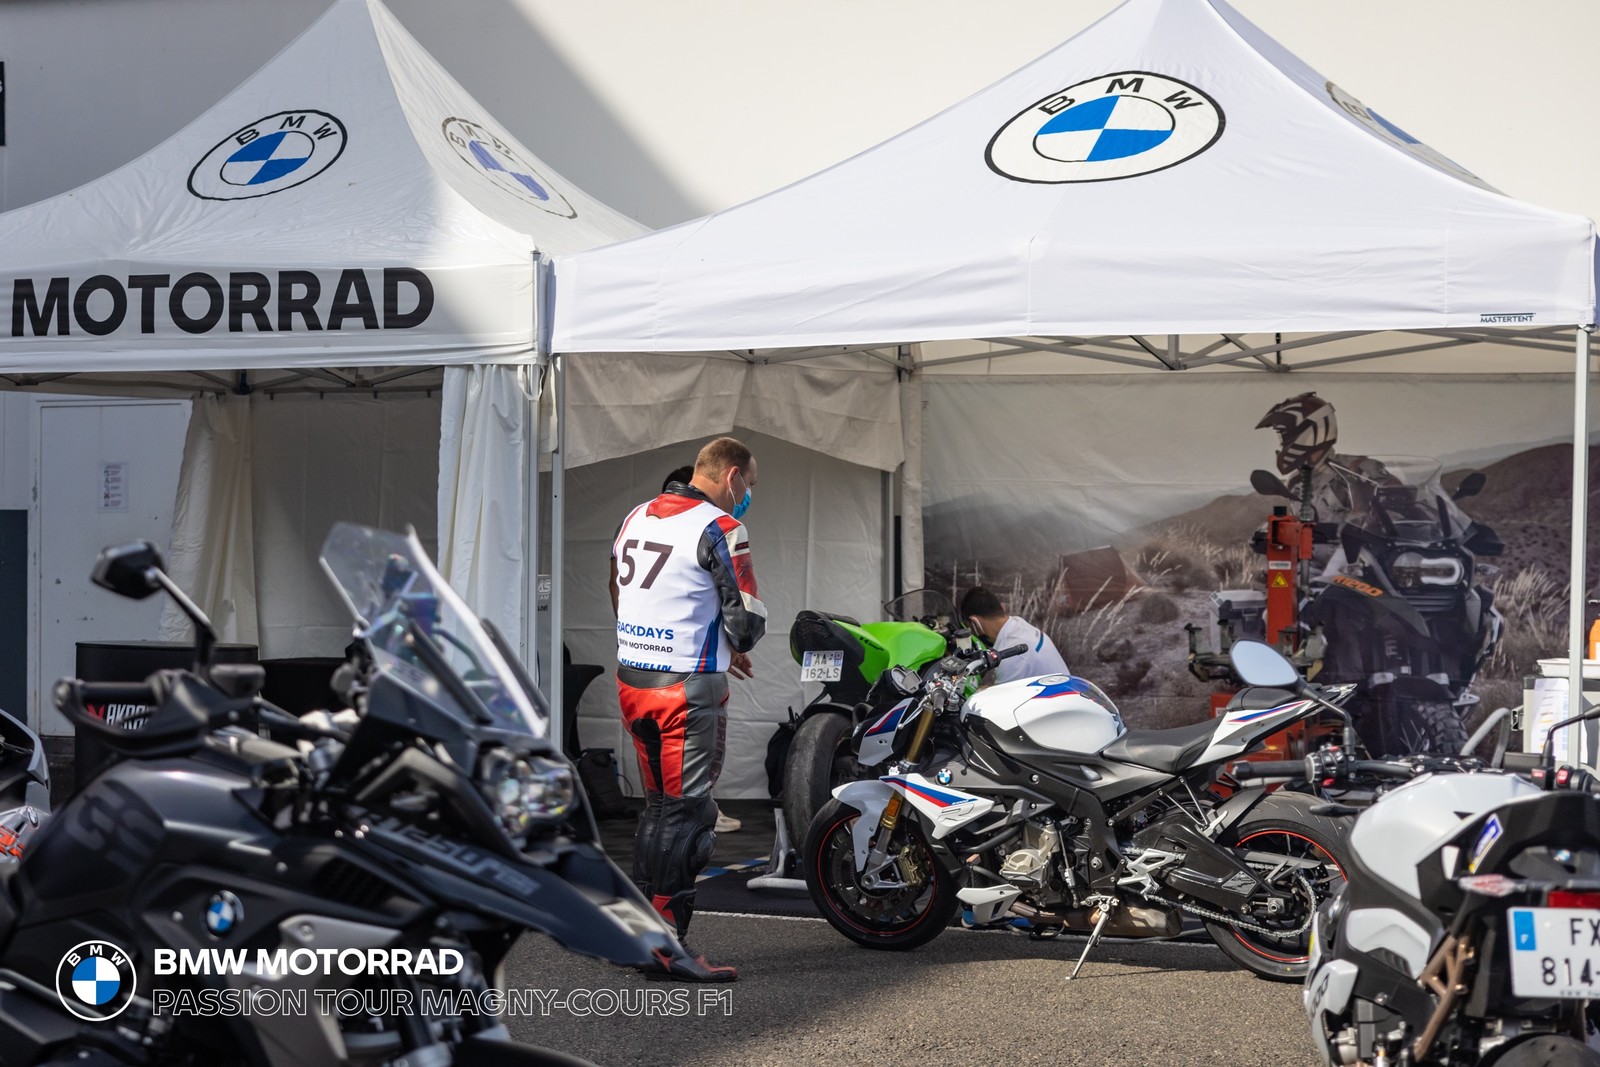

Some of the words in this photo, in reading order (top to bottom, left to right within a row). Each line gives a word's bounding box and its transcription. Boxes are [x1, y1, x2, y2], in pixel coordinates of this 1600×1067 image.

[1038, 77, 1203, 116] BMW
[235, 115, 338, 146] BMW
[11, 267, 434, 337] MOTORRAD
[1480, 315, 1534, 323] MASTERTENT
[619, 539, 674, 590] 57
[629, 641, 673, 653] MOTORRAD
[621, 658, 672, 671] MICHELIN
[805, 668, 840, 679] 162-LS
